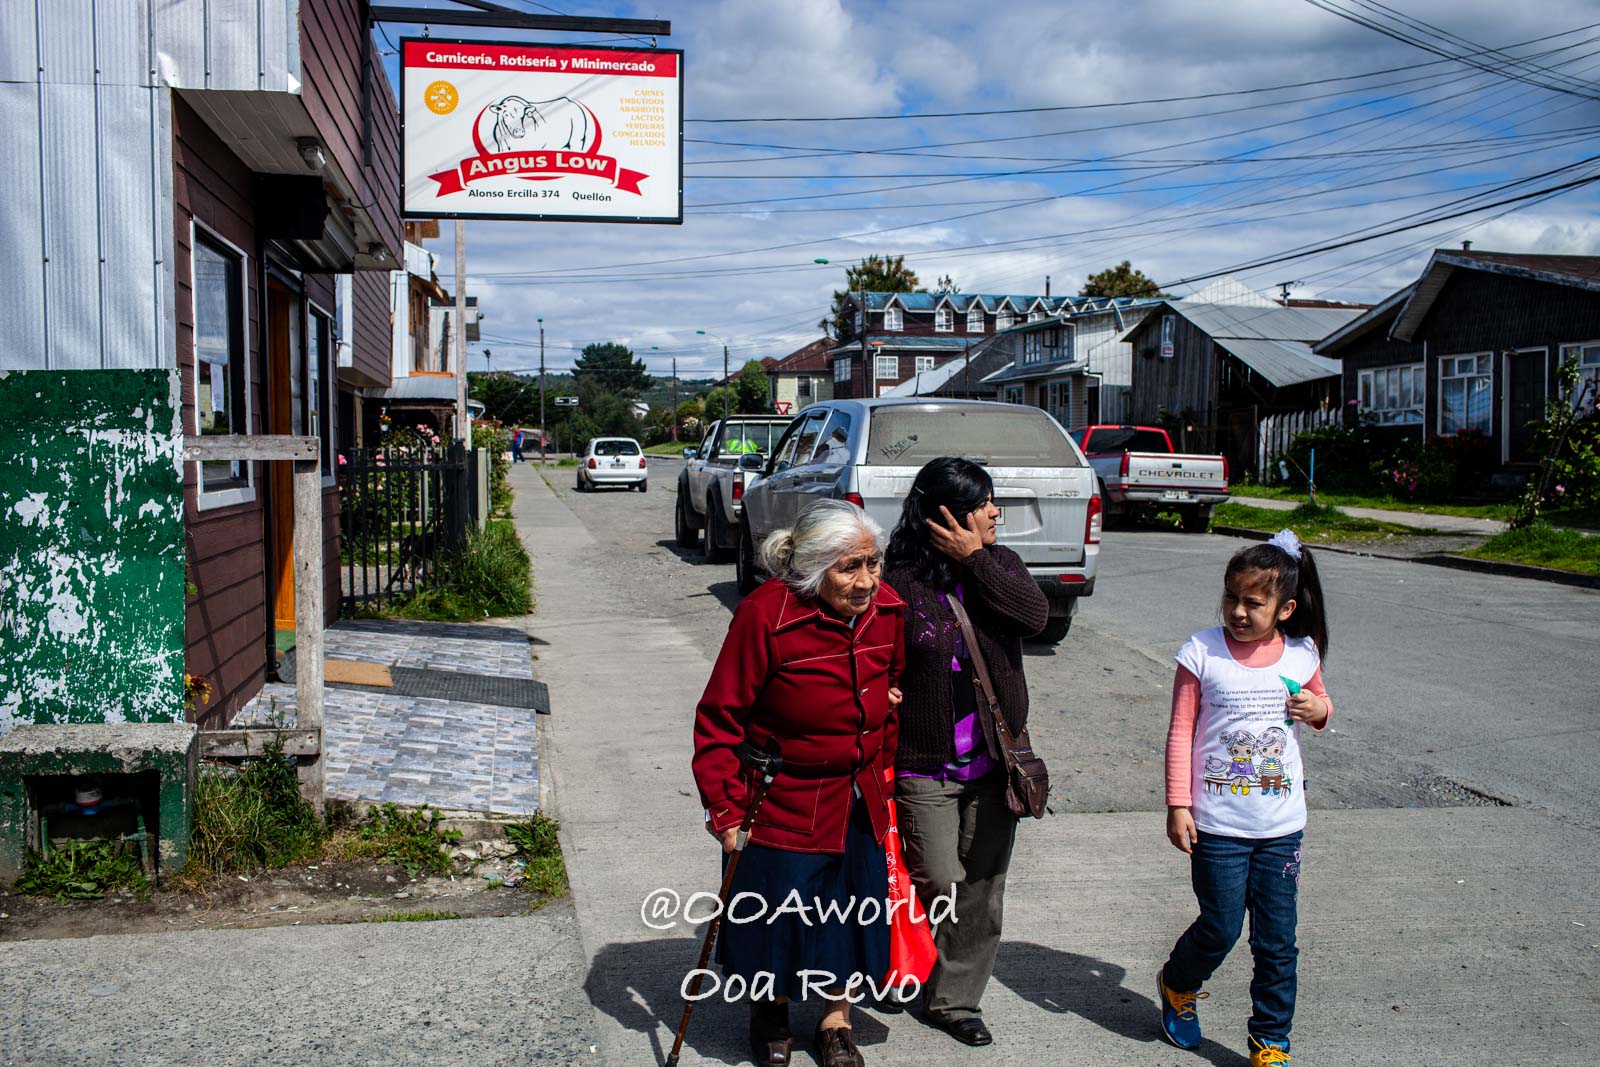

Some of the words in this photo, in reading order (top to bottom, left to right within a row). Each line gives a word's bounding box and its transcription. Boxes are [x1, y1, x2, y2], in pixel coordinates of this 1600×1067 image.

[426, 52, 496, 66] Carnicería,
[500, 55, 557, 67] Rotisería
[560, 59, 568, 70] y
[572, 58, 656, 72] Minimercado
[469, 155, 548, 176] Angus
[555, 152, 608, 171] Low
[468, 189, 504, 198] Alonso
[507, 189, 539, 198] Ercilla
[541, 190, 560, 198] 374
[572, 191, 612, 202] Quellón
[1138, 469, 1215, 479] CHEVROLET
